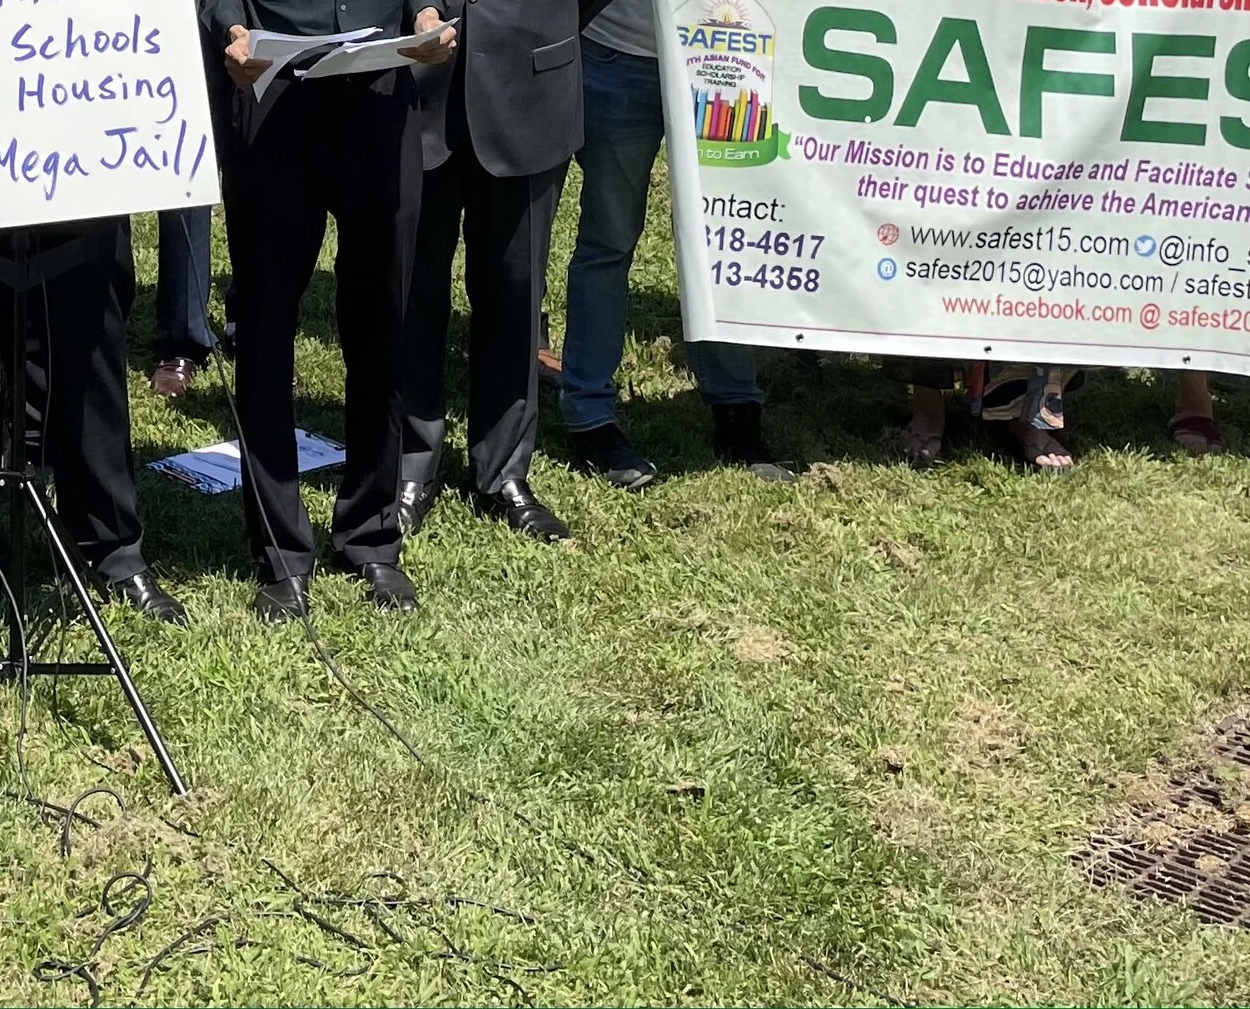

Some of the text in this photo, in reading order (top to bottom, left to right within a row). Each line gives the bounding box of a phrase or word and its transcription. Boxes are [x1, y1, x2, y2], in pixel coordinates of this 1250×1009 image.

[11, 14, 161, 61] Schools
[696, 70, 745, 80] SCHOLARSHIP
[702, 63, 742, 73] EDUCATION
[18, 72, 178, 123] Housing
[100, 119, 208, 198] Jail!
[706, 147, 721, 159] to
[725, 148, 760, 160] Earn
[844, 140, 929, 170] Mission
[935, 147, 955, 172] is
[963, 151, 986, 175] to
[993, 153, 1085, 181] Educate
[1088, 159, 1129, 182] and
[1134, 160, 1238, 189] Facilitate
[857, 175, 1250, 223] their quest to achieve the American
[910, 226, 1129, 256] www.safest15.com
[905, 257, 1163, 293] safest2015@yahoo.com
[1170, 272, 1179, 293] /
[942, 294, 1132, 324] www.facebook.com
[1139, 302, 1161, 330] @
